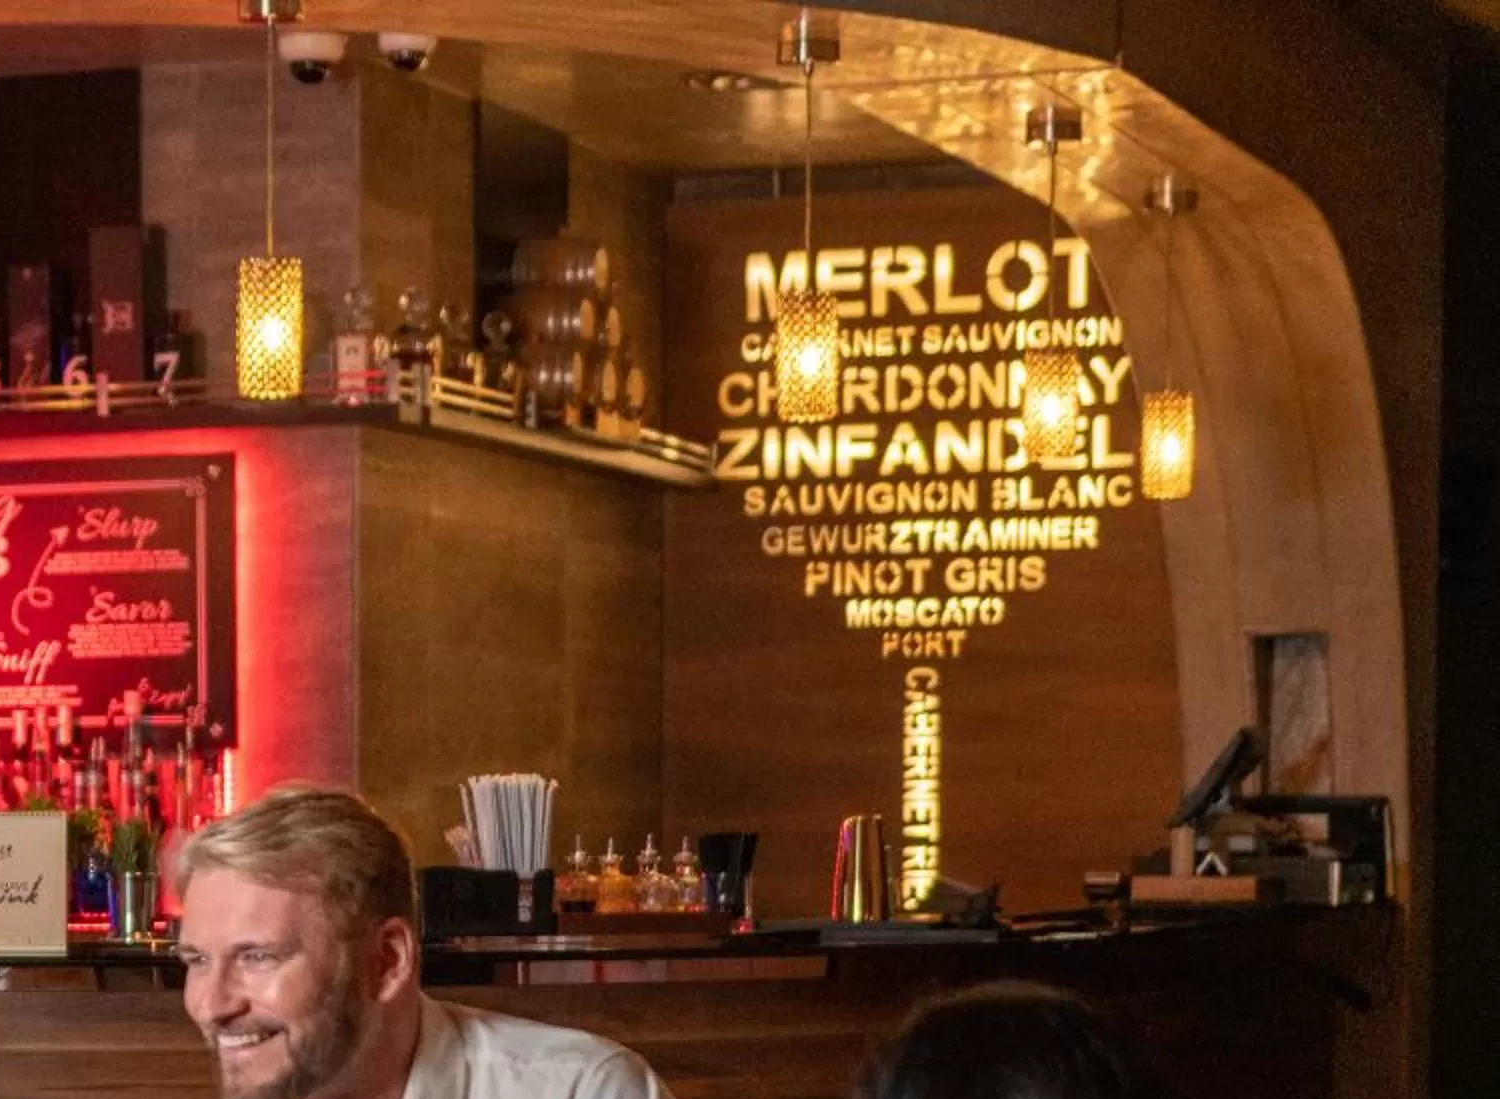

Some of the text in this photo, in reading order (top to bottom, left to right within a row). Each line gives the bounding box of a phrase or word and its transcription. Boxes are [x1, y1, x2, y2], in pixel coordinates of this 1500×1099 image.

[743, 236, 1091, 321] MERLOT
[921, 317, 1124, 355] SAUVIGNON
[63, 355, 89, 397] 6
[153, 351, 180, 394] 7
[713, 415, 1136, 481] ZINFANDEL
[743, 475, 1134, 517] SAUVIGNON BLANC
[761, 516, 1099, 557] GEWURZTRAMINER
[805, 556, 1047, 598] PINOT GRIS
[845, 597, 1005, 629] MOSCATO
[881, 630, 968, 658] PORT
[902, 666, 941, 842] CABERNET
